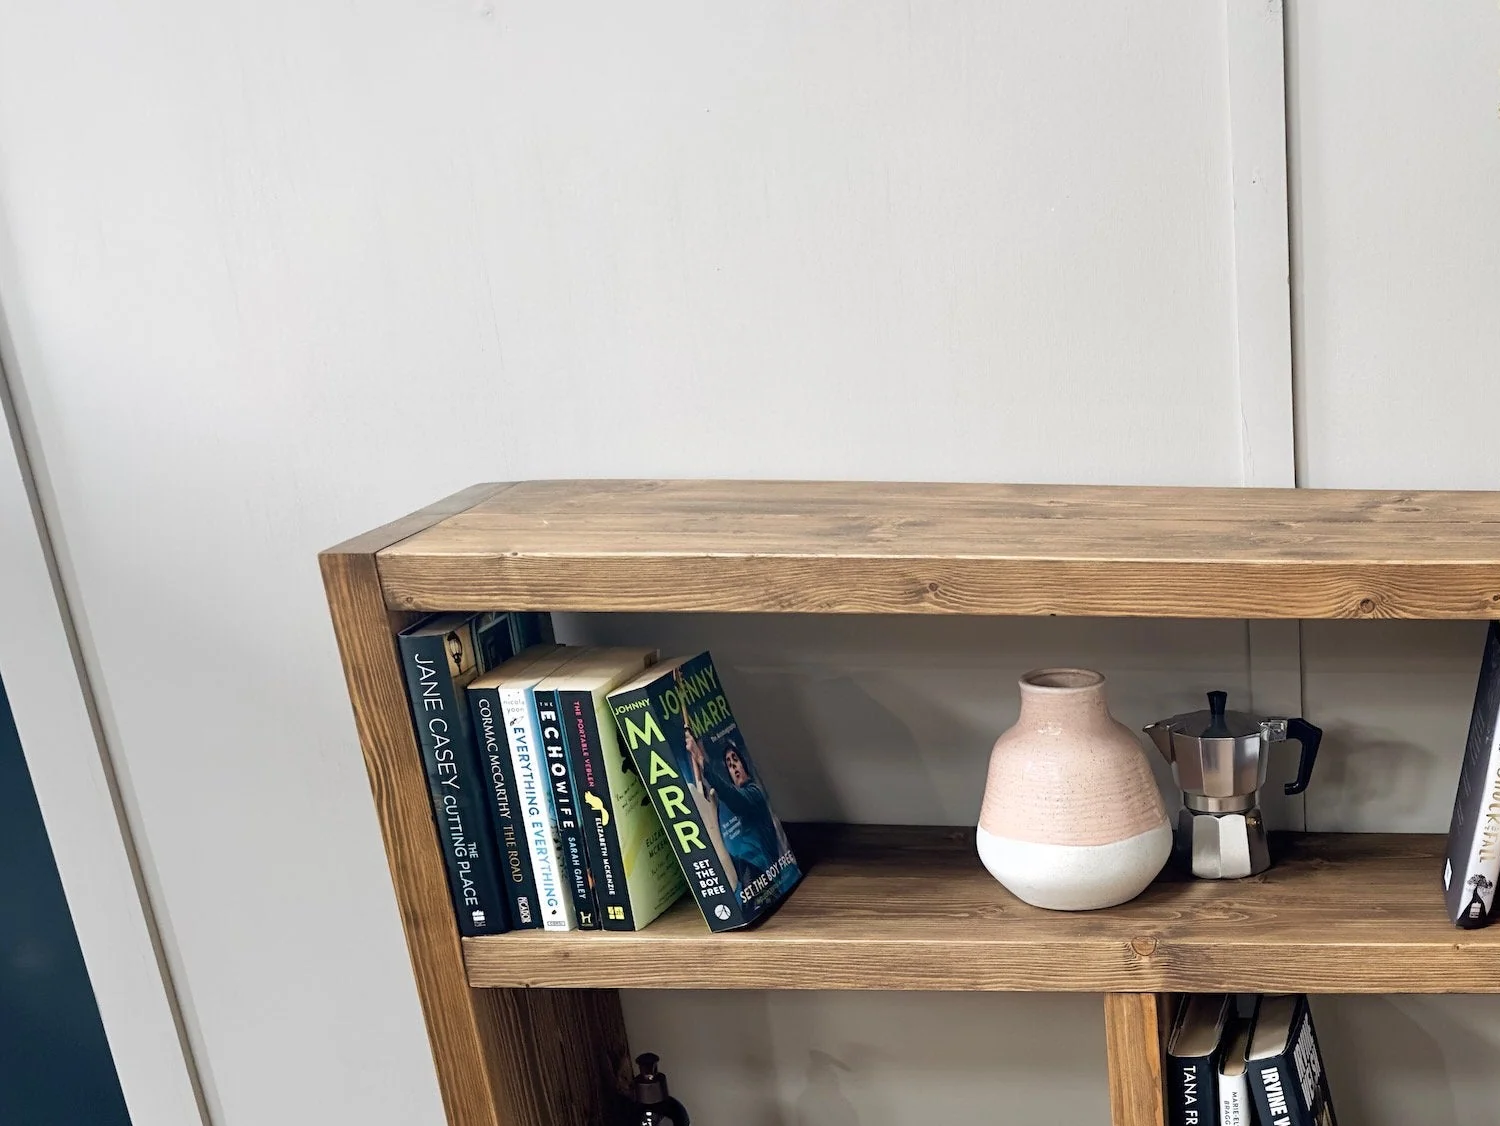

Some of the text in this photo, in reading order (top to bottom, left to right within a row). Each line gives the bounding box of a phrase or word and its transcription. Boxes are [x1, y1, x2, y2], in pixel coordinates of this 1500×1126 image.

[415, 653, 460, 790] JANE CASEY
[478, 698, 499, 752] CORMAC
[614, 698, 650, 716] JOHNNY
[688, 695, 731, 738] MARR
[540, 710, 574, 828] ECHO WIFE
[574, 701, 595, 788] THE PORTABLE VEBLEN
[624, 711, 706, 854] MARR
[443, 795, 479, 906] CUTTING PLACE
[467, 842, 479, 859] THE
[503, 824, 523, 883] THE ROAD
[595, 817, 608, 858] ELIZABETH
[1479, 832, 1499, 863] FALL
[532, 821, 558, 907] EVERYTHING
[567, 837, 587, 899] SARAH GAILEY
[693, 859, 710, 871] SET
[695, 868, 716, 880] THE
[699, 877, 720, 889] BOY
[740, 886, 754, 903] SET
[753, 874, 768, 893] THE
[765, 863, 779, 881] BOY
[778, 850, 794, 870] FREE
[701, 885, 726, 898] FREE
[1183, 1065, 1198, 1105] TANA
[1260, 1067, 1288, 1116] IRVINE
